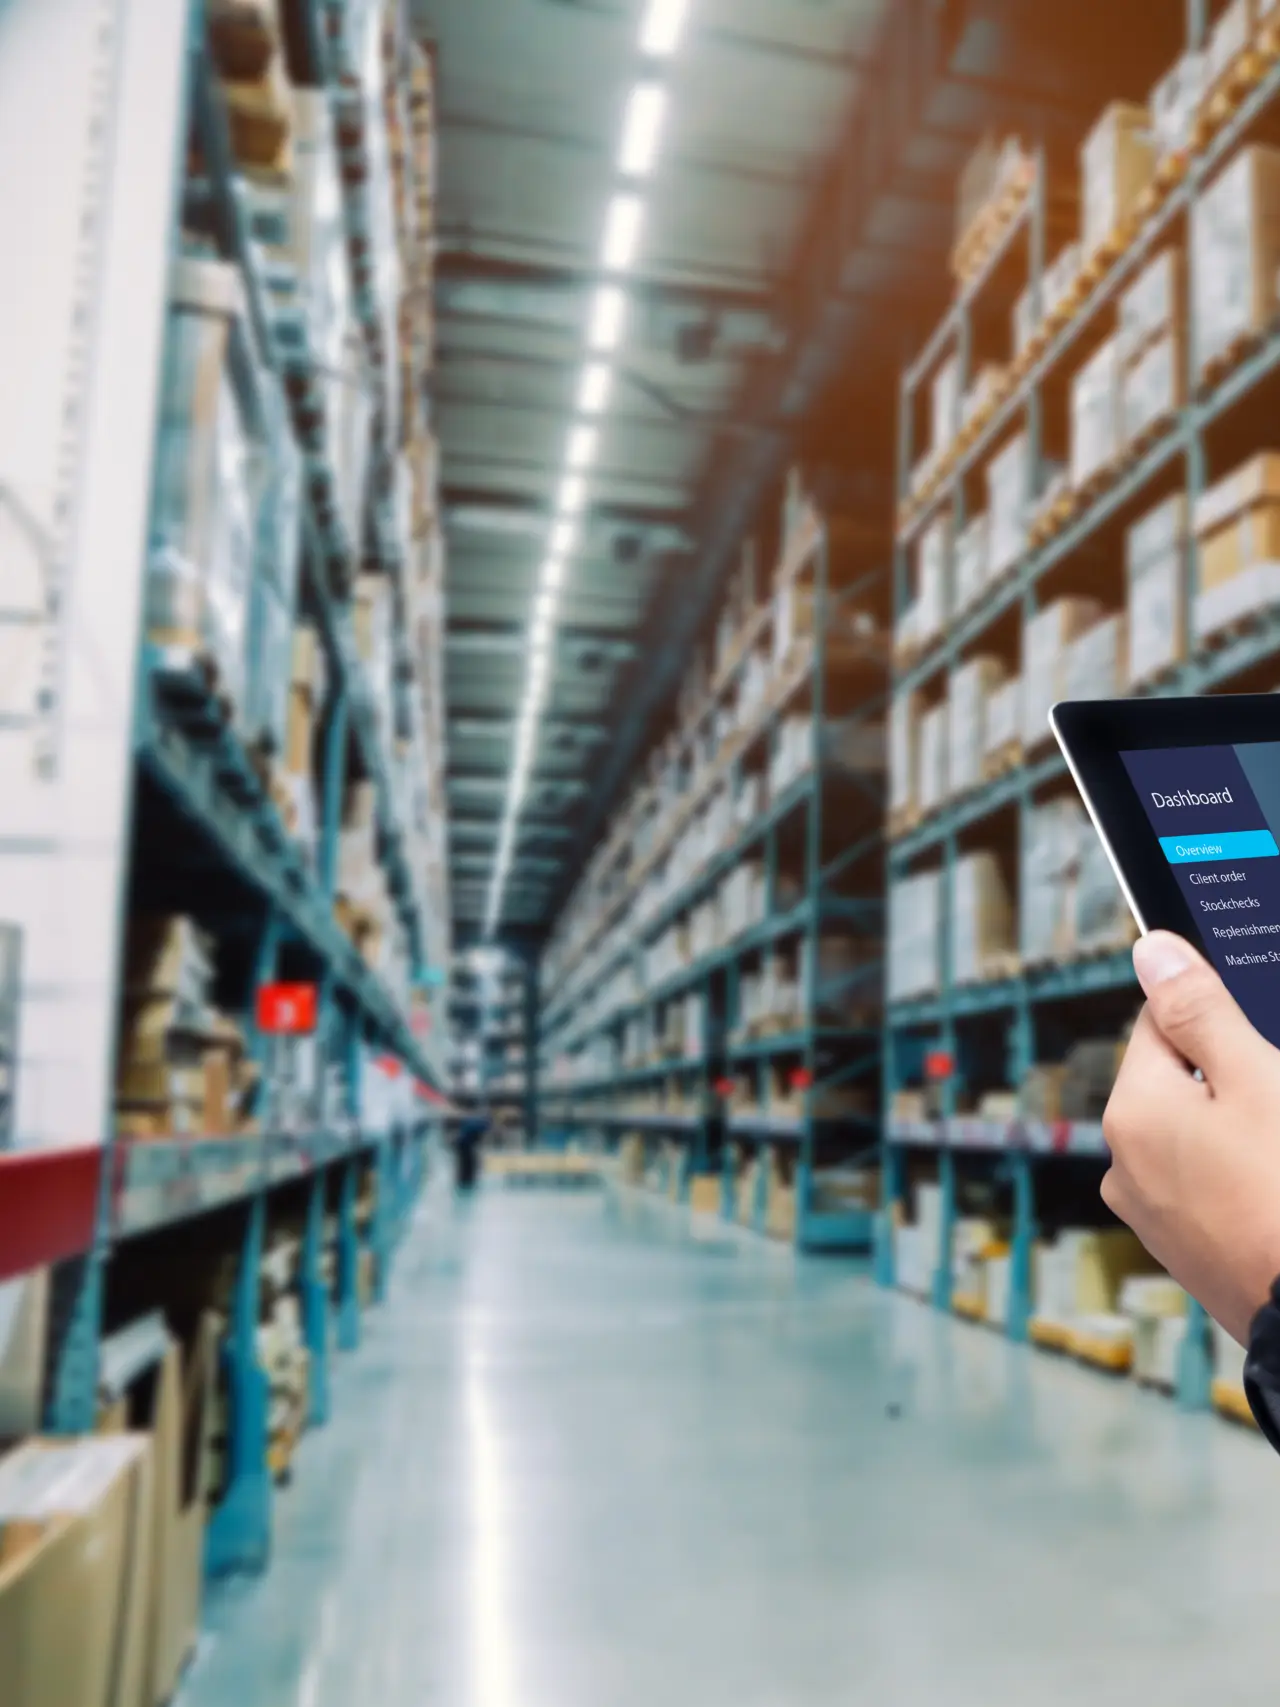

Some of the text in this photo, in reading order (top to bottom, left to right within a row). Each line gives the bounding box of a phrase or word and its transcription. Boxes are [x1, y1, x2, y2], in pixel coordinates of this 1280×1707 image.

[1151, 787, 1234, 808] Dashboard
[1175, 843, 1223, 857] Overview
[1220, 870, 1247, 883] order
[1200, 896, 1261, 912] Stockchecks
[1225, 951, 1269, 967] Machine
